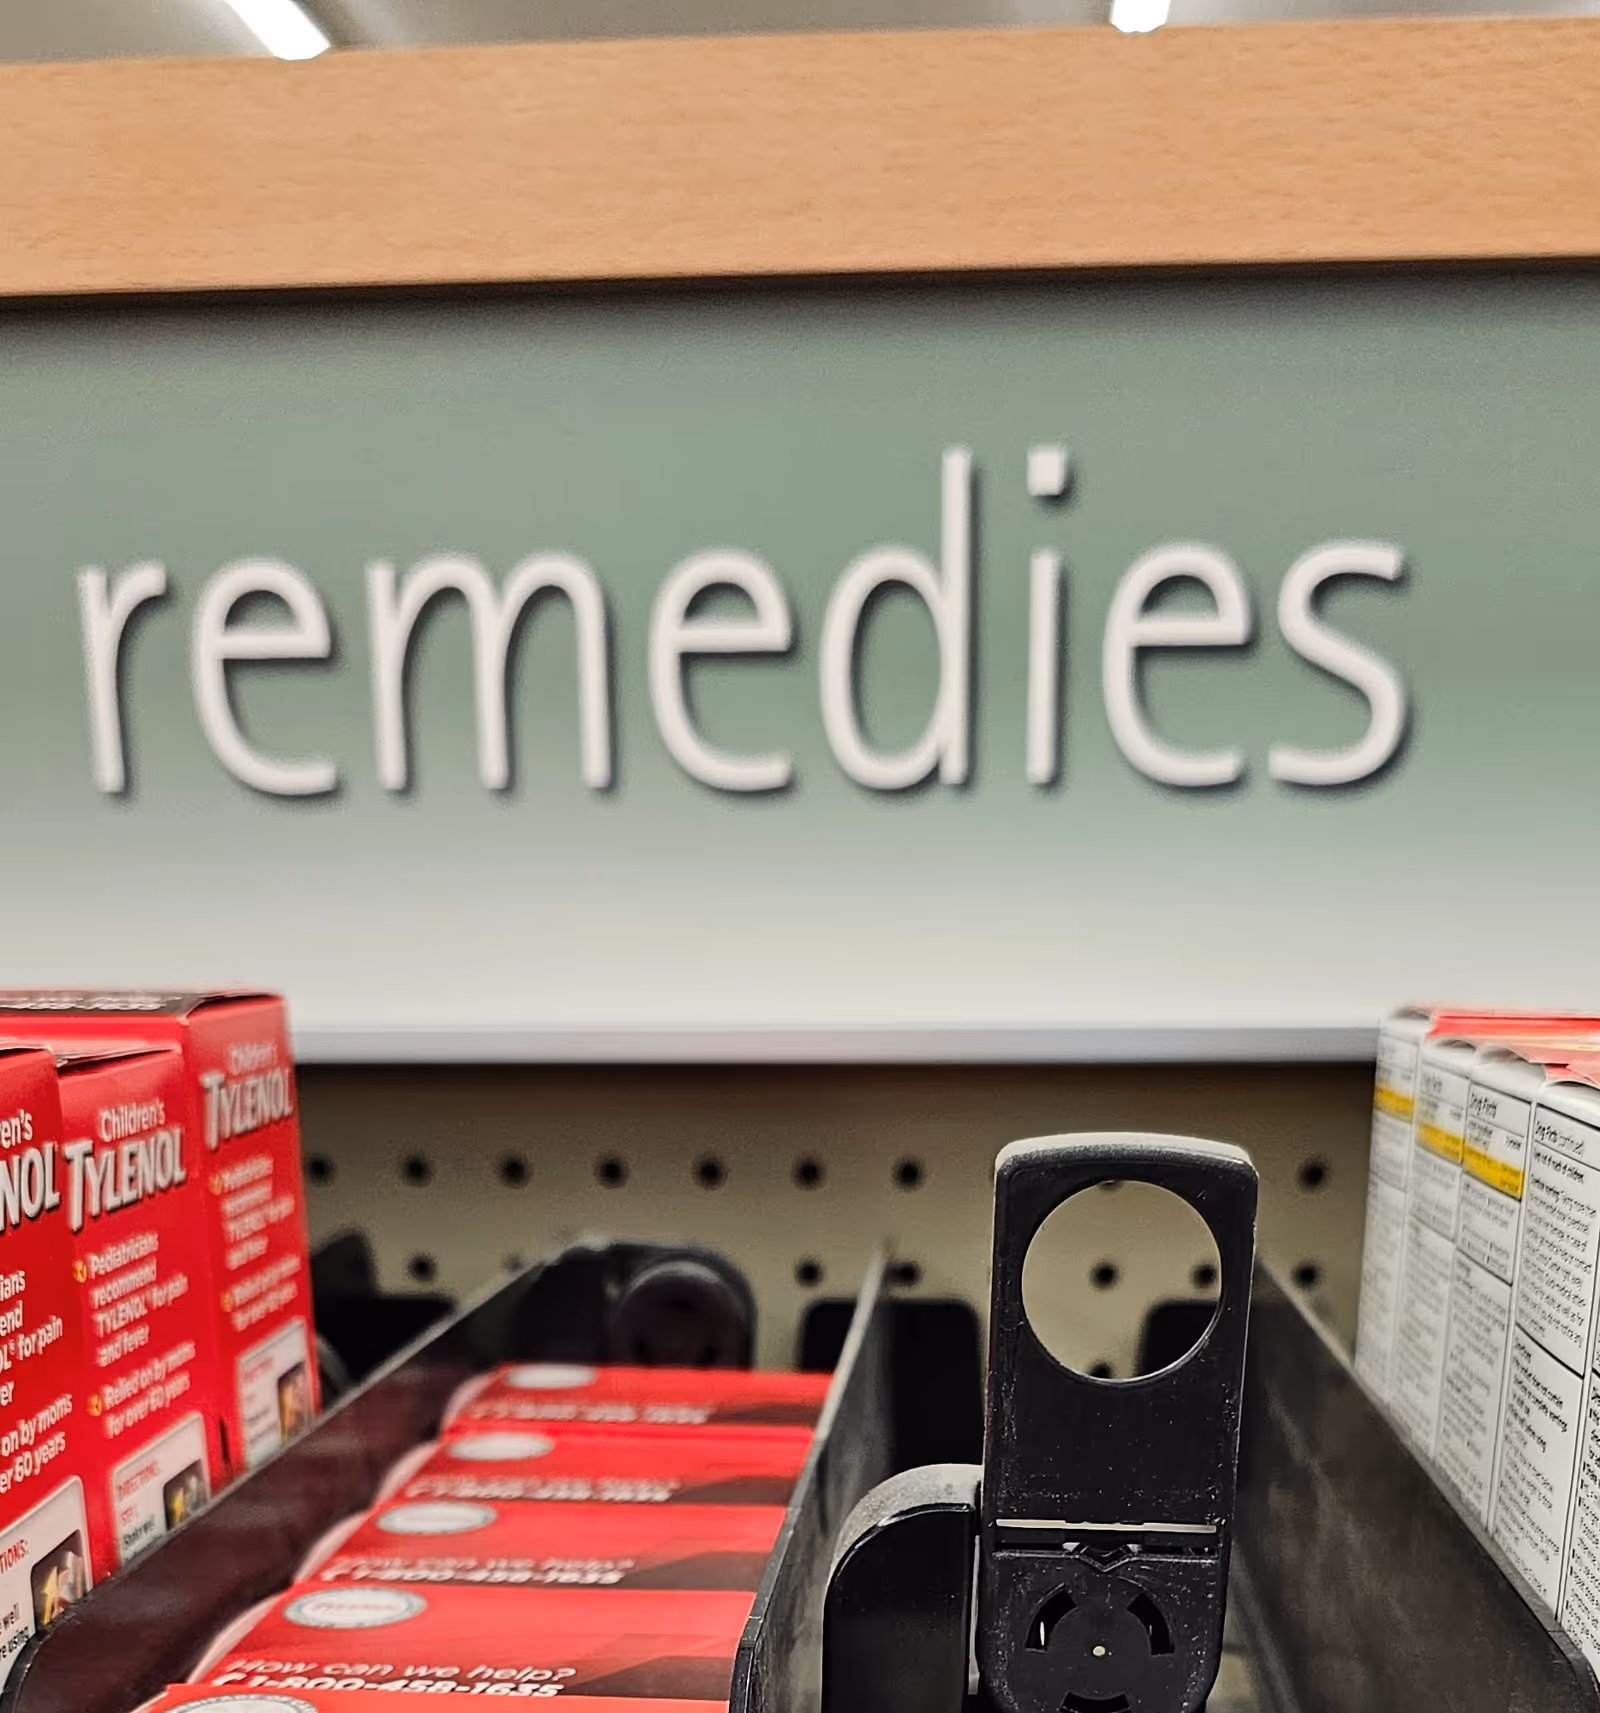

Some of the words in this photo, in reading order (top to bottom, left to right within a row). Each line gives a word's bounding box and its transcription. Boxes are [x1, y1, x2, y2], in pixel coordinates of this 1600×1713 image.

[76, 446, 1408, 796] remedies
[100, 1097, 165, 1142] Children's
[201, 1068, 293, 1150] TYLENOL
[64, 1126, 185, 1232] TYLENOL
[39, 1315, 62, 1353] pain
[38, 1395, 72, 1432] moms
[34, 1432, 65, 1475] years
[224, 1660, 319, 1675] How
[323, 1663, 393, 1677] can
[403, 1664, 461, 1678] we
[466, 1666, 576, 1682] help?
